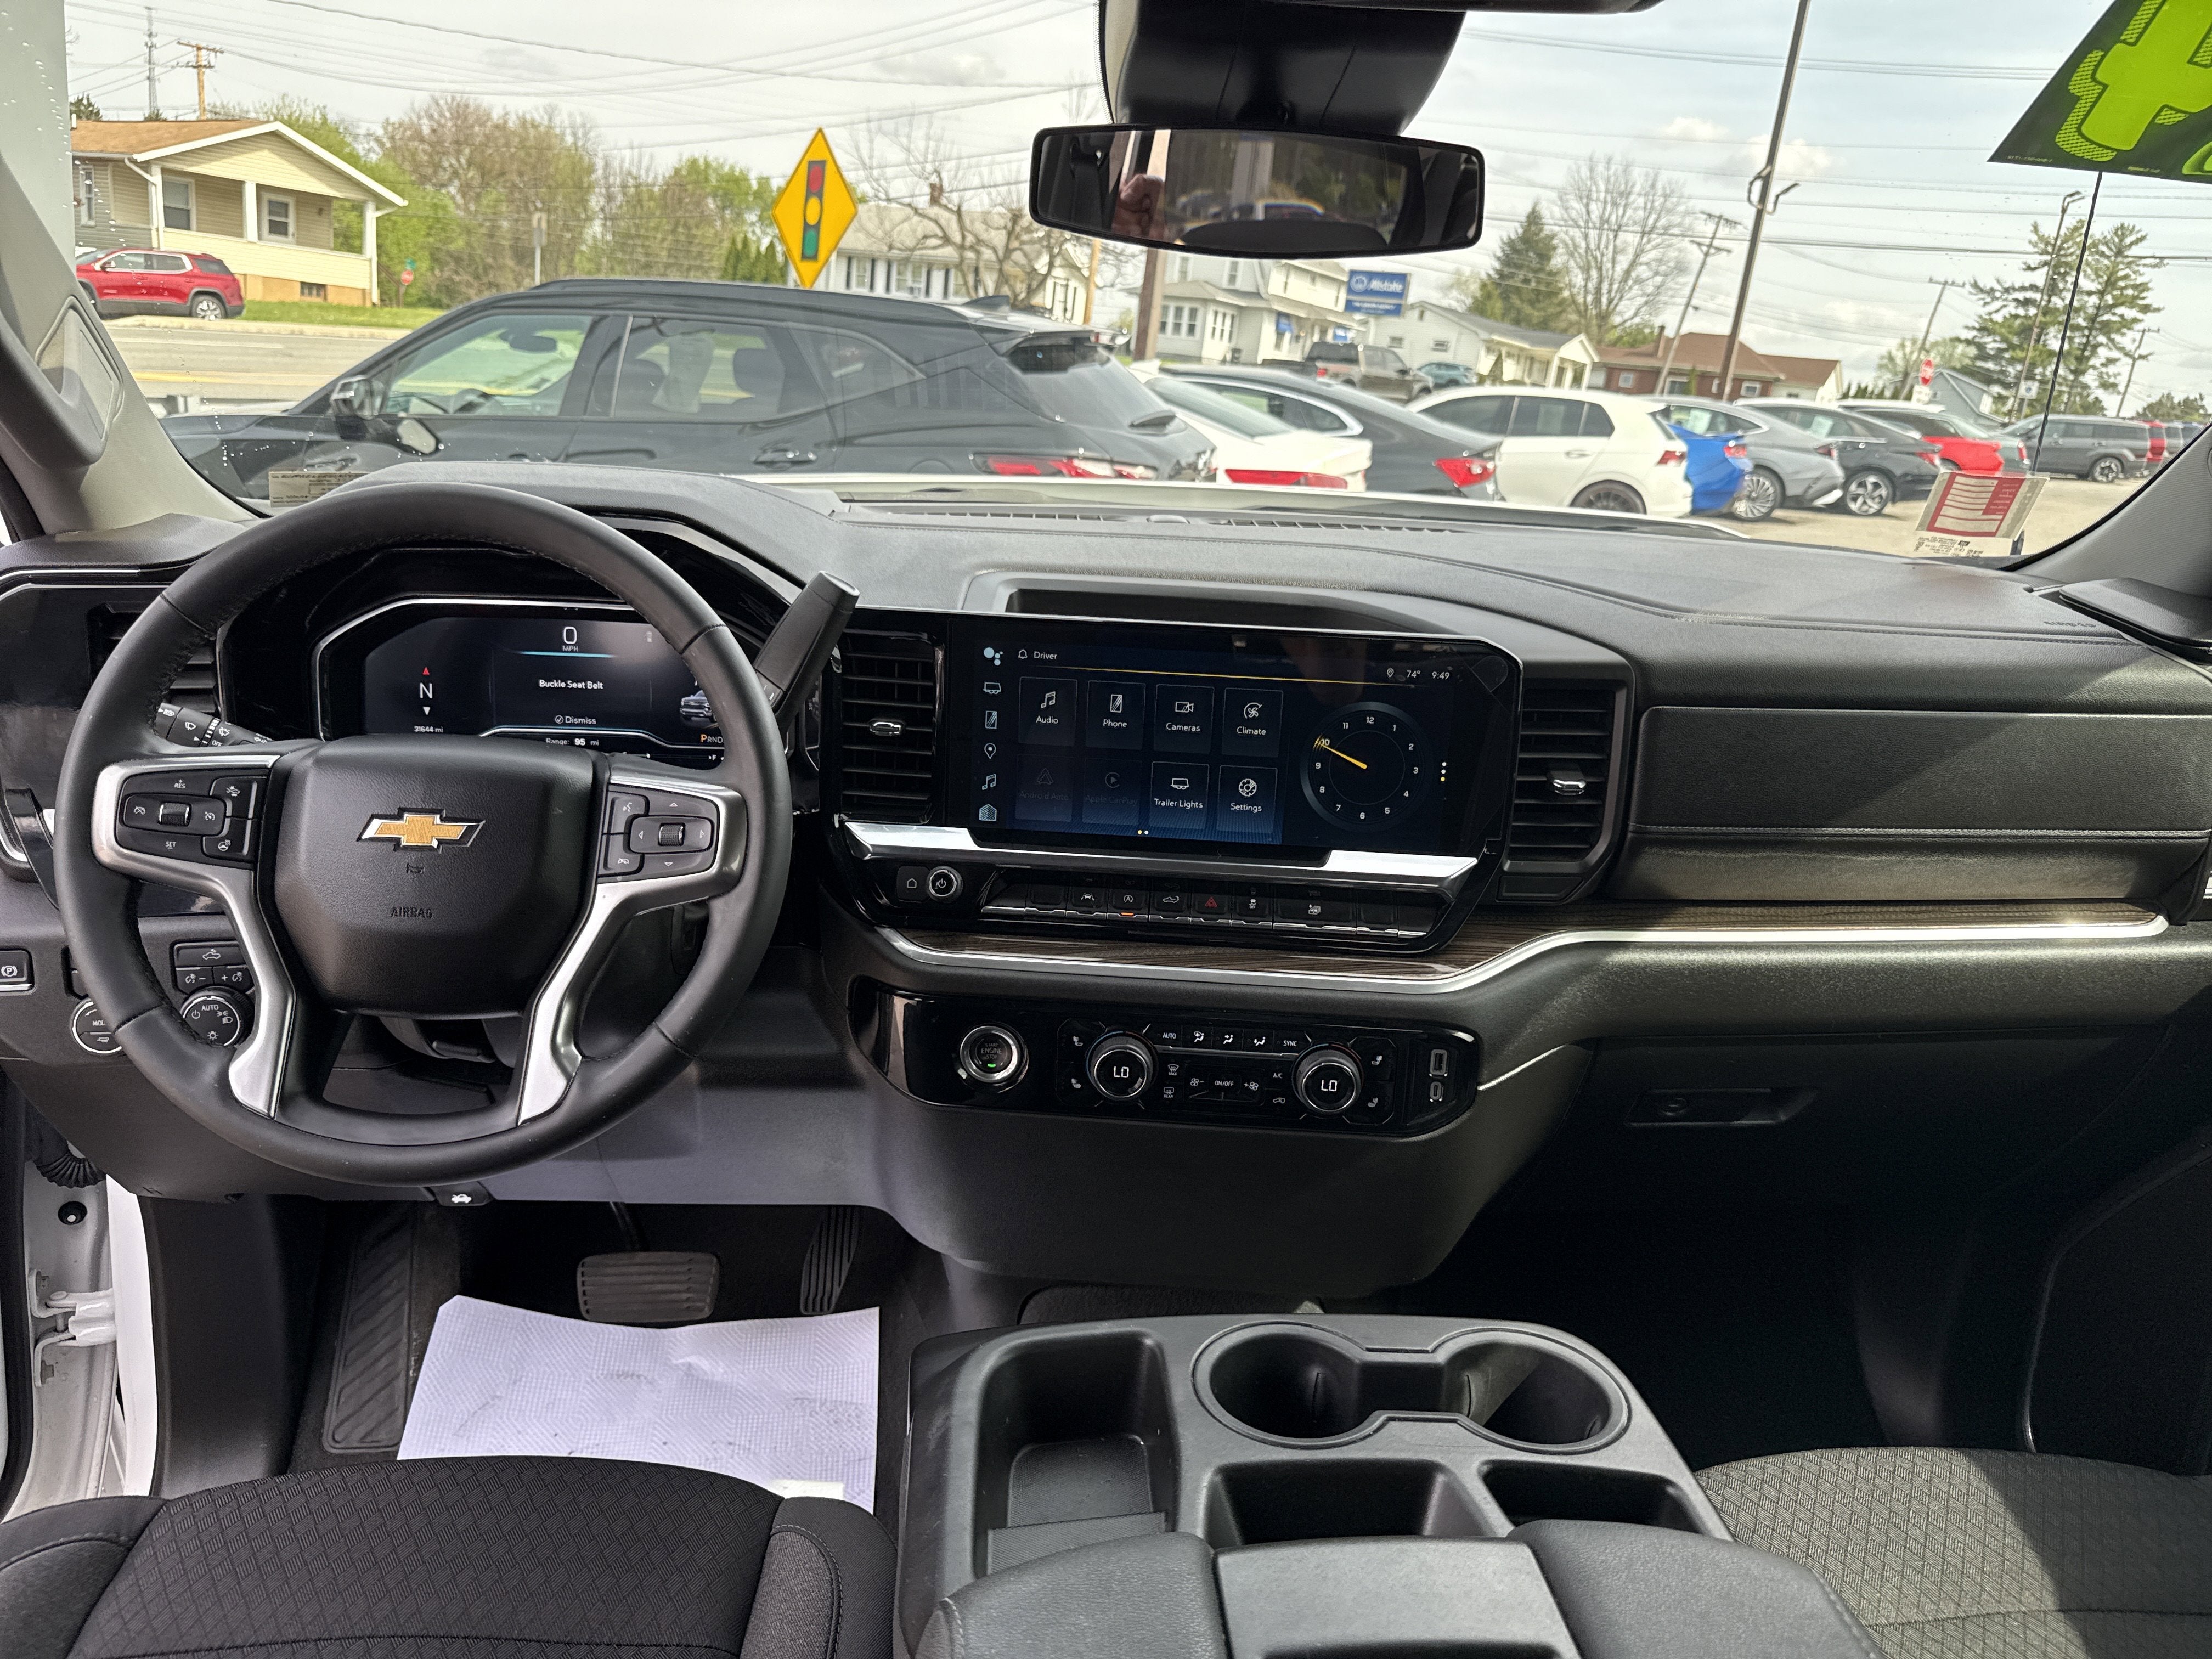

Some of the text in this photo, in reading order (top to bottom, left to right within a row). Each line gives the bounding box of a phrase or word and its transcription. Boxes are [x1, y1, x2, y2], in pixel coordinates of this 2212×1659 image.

[563, 626, 577, 644] 0
[1034, 651, 1058, 660] Driver
[1407, 670, 1450, 680] 74° 9:49
[539, 679, 603, 690] Buckle Seat Belt
[419, 682, 433, 699] N
[566, 716, 596, 724] Dismiss
[1036, 715, 1058, 724] Audio
[1103, 719, 1127, 728] Phone
[1166, 723, 1200, 732] Cameras
[1237, 726, 1266, 735] Climate
[1019, 791, 1049, 800] Android
[1086, 795, 1137, 806] Apple CarPlay
[1154, 798, 1203, 810] Trailer Lights
[1231, 803, 1262, 813] Settings
[391, 906, 433, 918] AIRBAG
